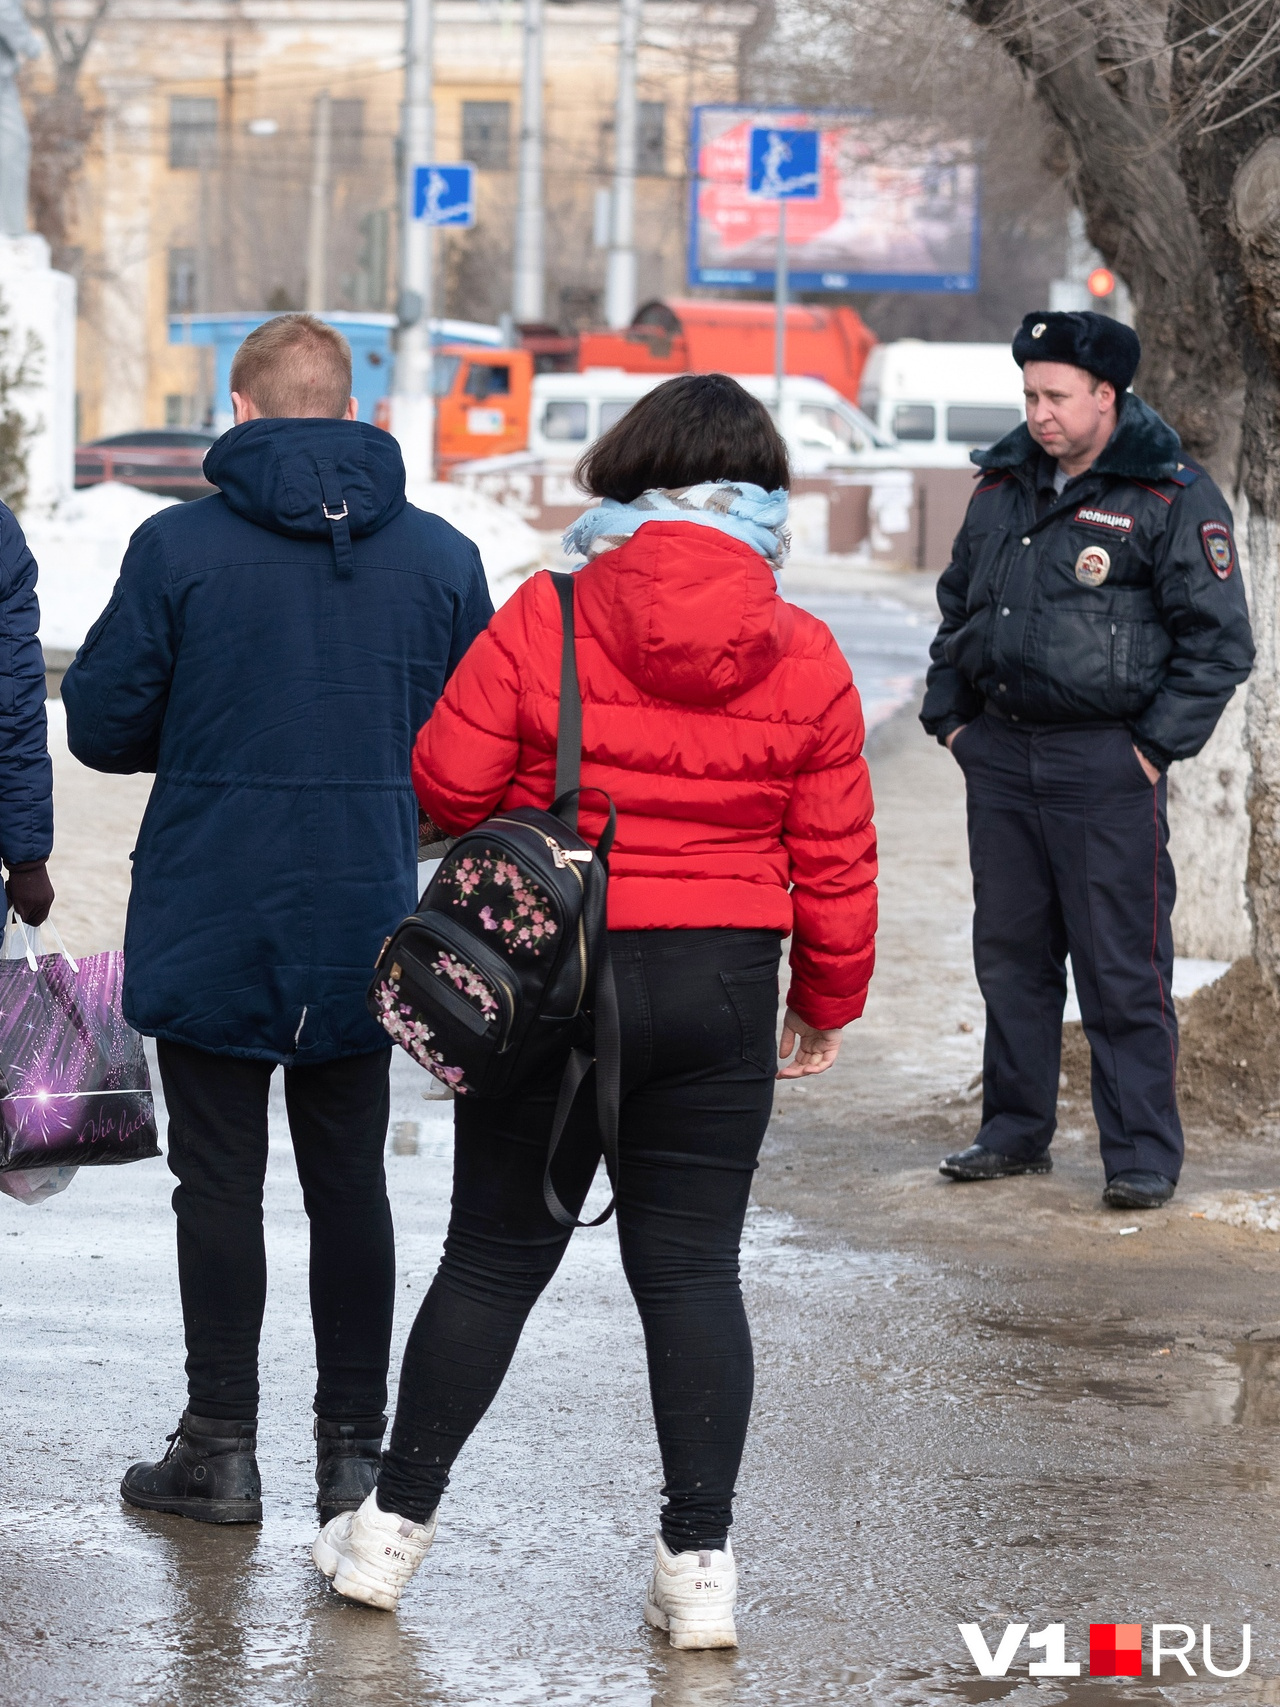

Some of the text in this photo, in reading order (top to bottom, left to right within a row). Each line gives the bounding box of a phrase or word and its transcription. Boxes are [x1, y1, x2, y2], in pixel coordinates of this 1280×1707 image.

[1078, 510, 1131, 528] ПОЛИЦИЯ
[384, 1546, 406, 1561] SML
[695, 1581, 719, 1590] SML
